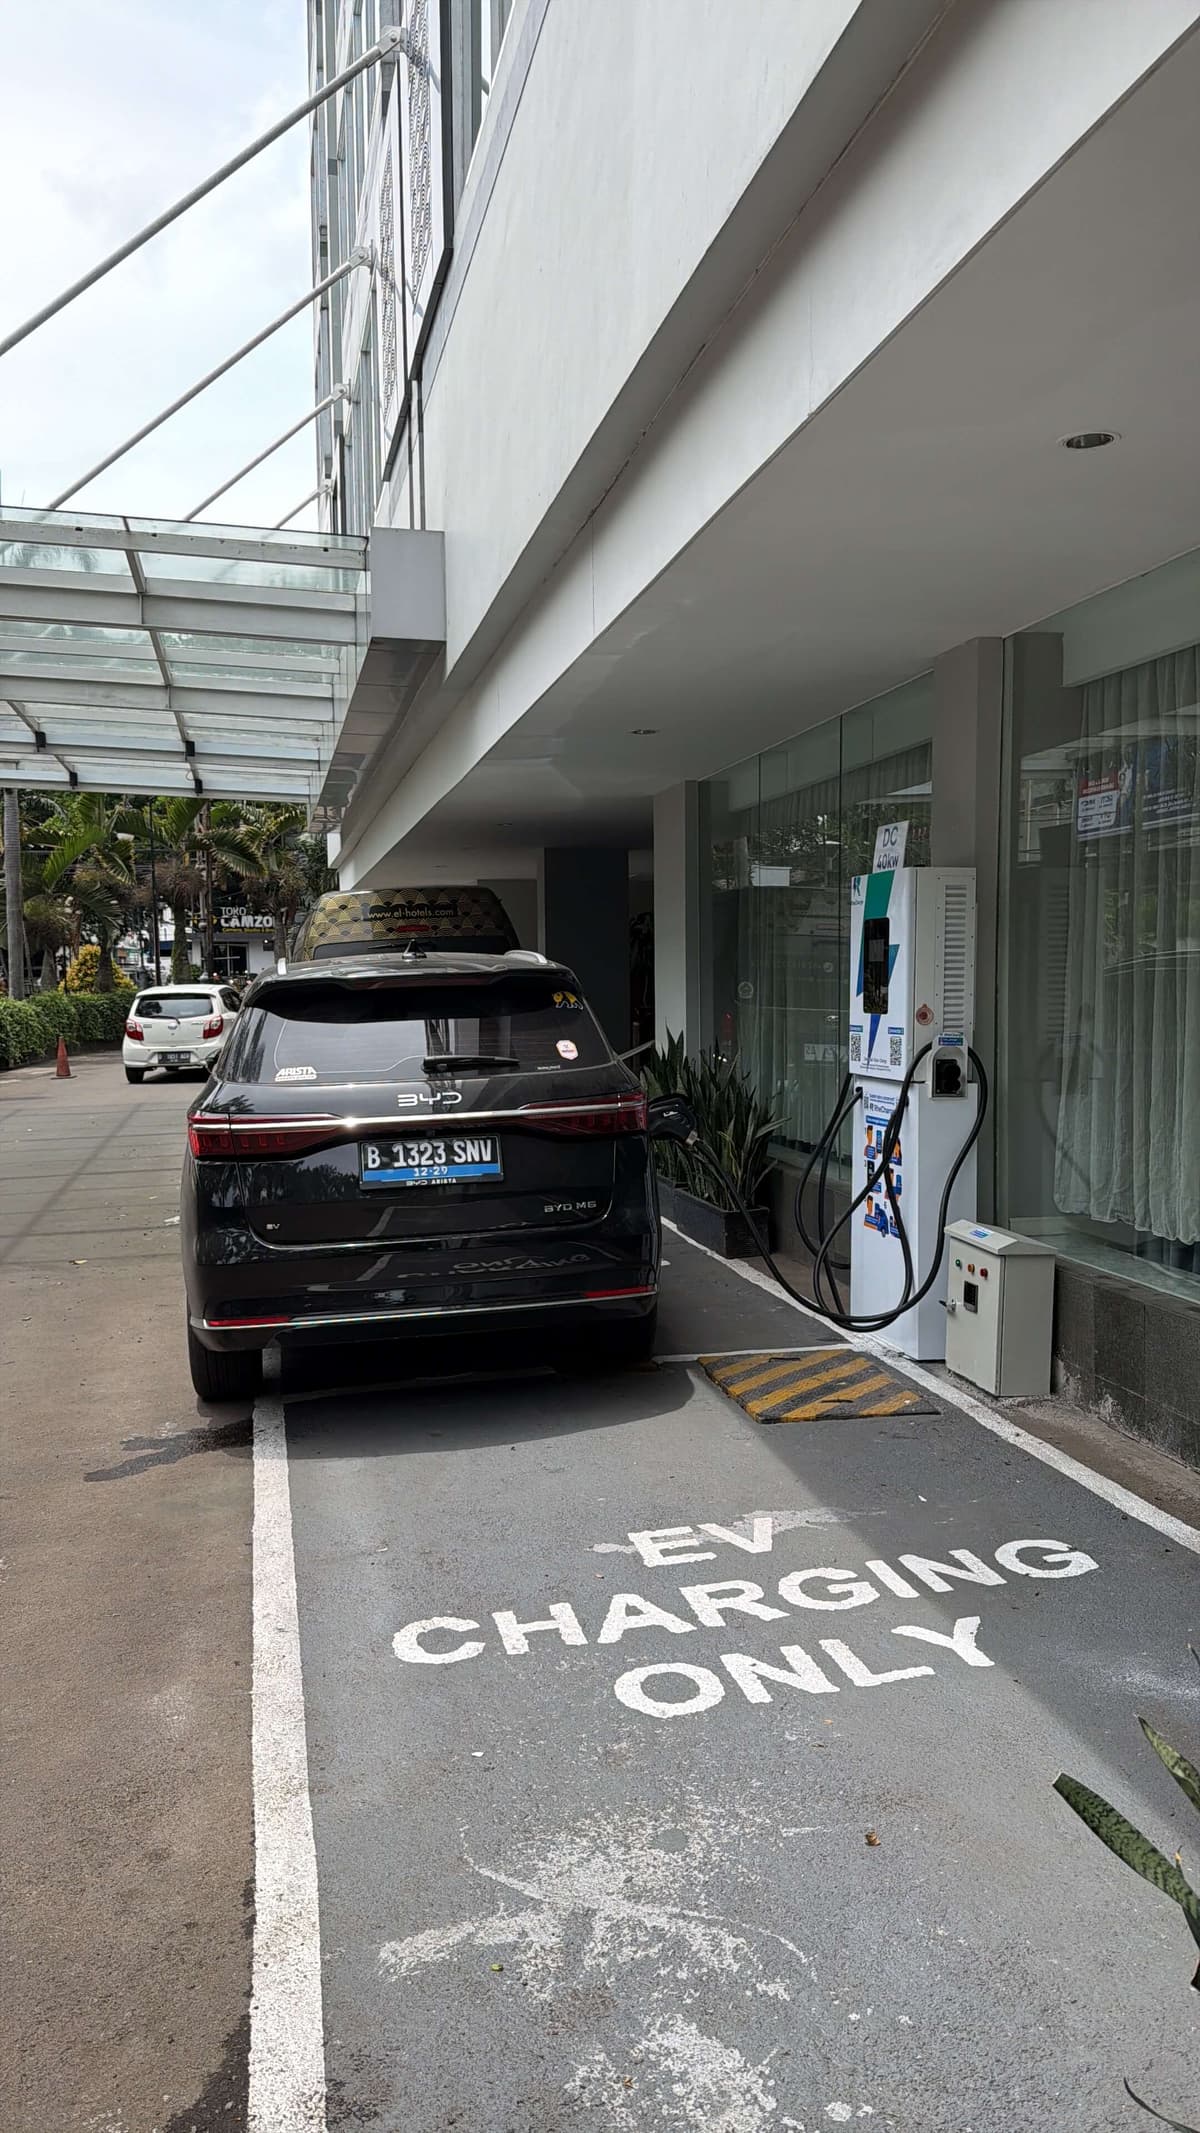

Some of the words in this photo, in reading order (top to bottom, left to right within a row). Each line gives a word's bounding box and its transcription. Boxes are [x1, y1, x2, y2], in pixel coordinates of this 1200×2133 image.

[883, 826, 898, 848] DC
[221, 906, 247, 916] TOKO
[220, 914, 275, 928] CAMZO
[276, 1066, 317, 1077] ARISTA
[397, 1091, 462, 1107] BYD
[367, 1146, 381, 1169] B
[392, 1142, 446, 1167] 1323
[453, 1139, 492, 1164] SNV
[544, 1203, 573, 1213] BYD
[628, 1517, 773, 1568] EV
[391, 1538, 1100, 1665] CHARGING
[613, 1615, 995, 1718] ONLY
